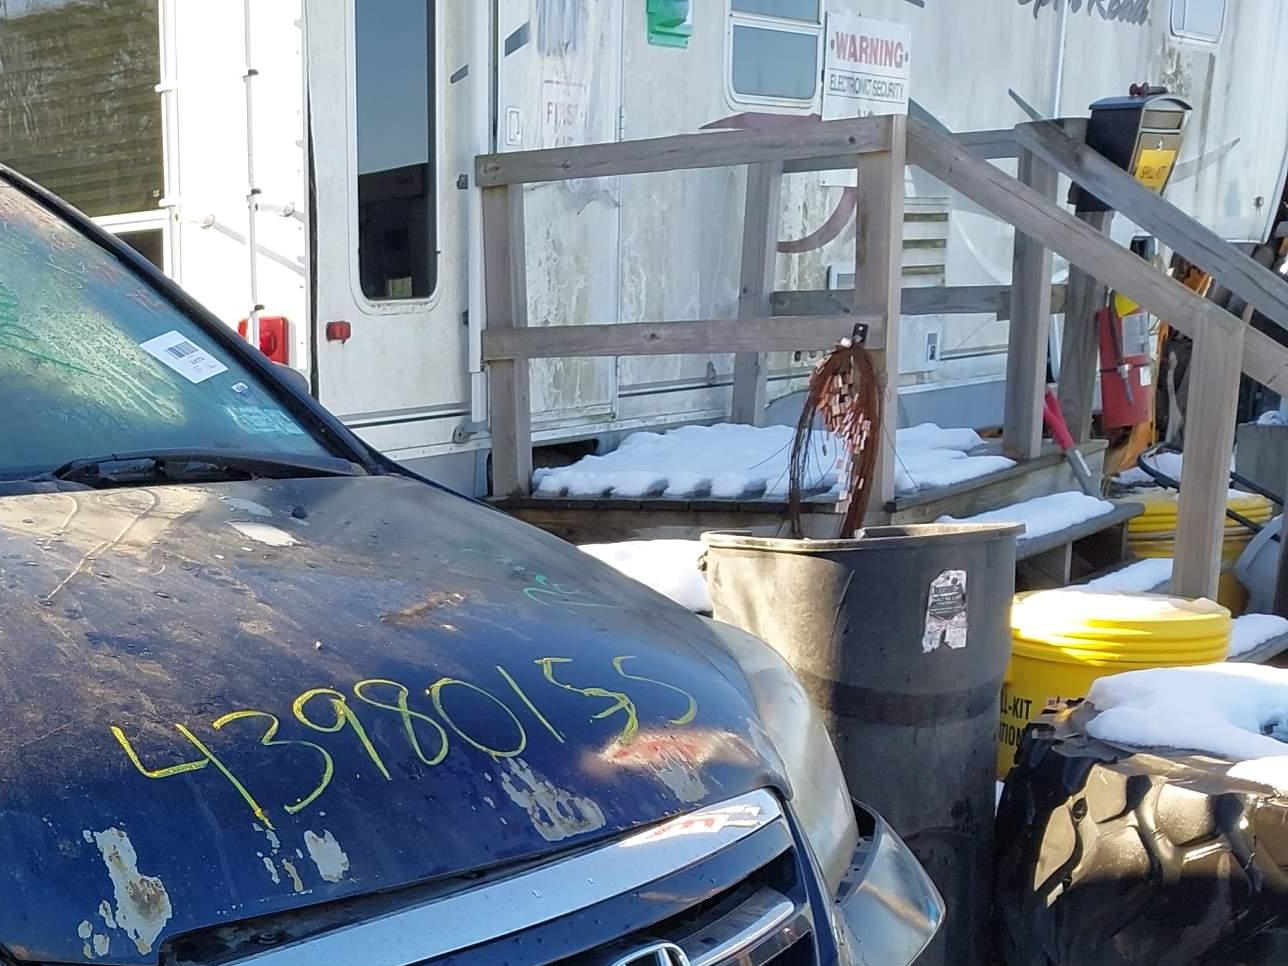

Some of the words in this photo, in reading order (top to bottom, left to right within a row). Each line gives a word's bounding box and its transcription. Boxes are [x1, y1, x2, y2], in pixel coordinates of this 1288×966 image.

[835, 31, 904, 68] WARNING
[872, 80, 905, 98] SECURITY
[110, 656, 698, 830] 43980155
